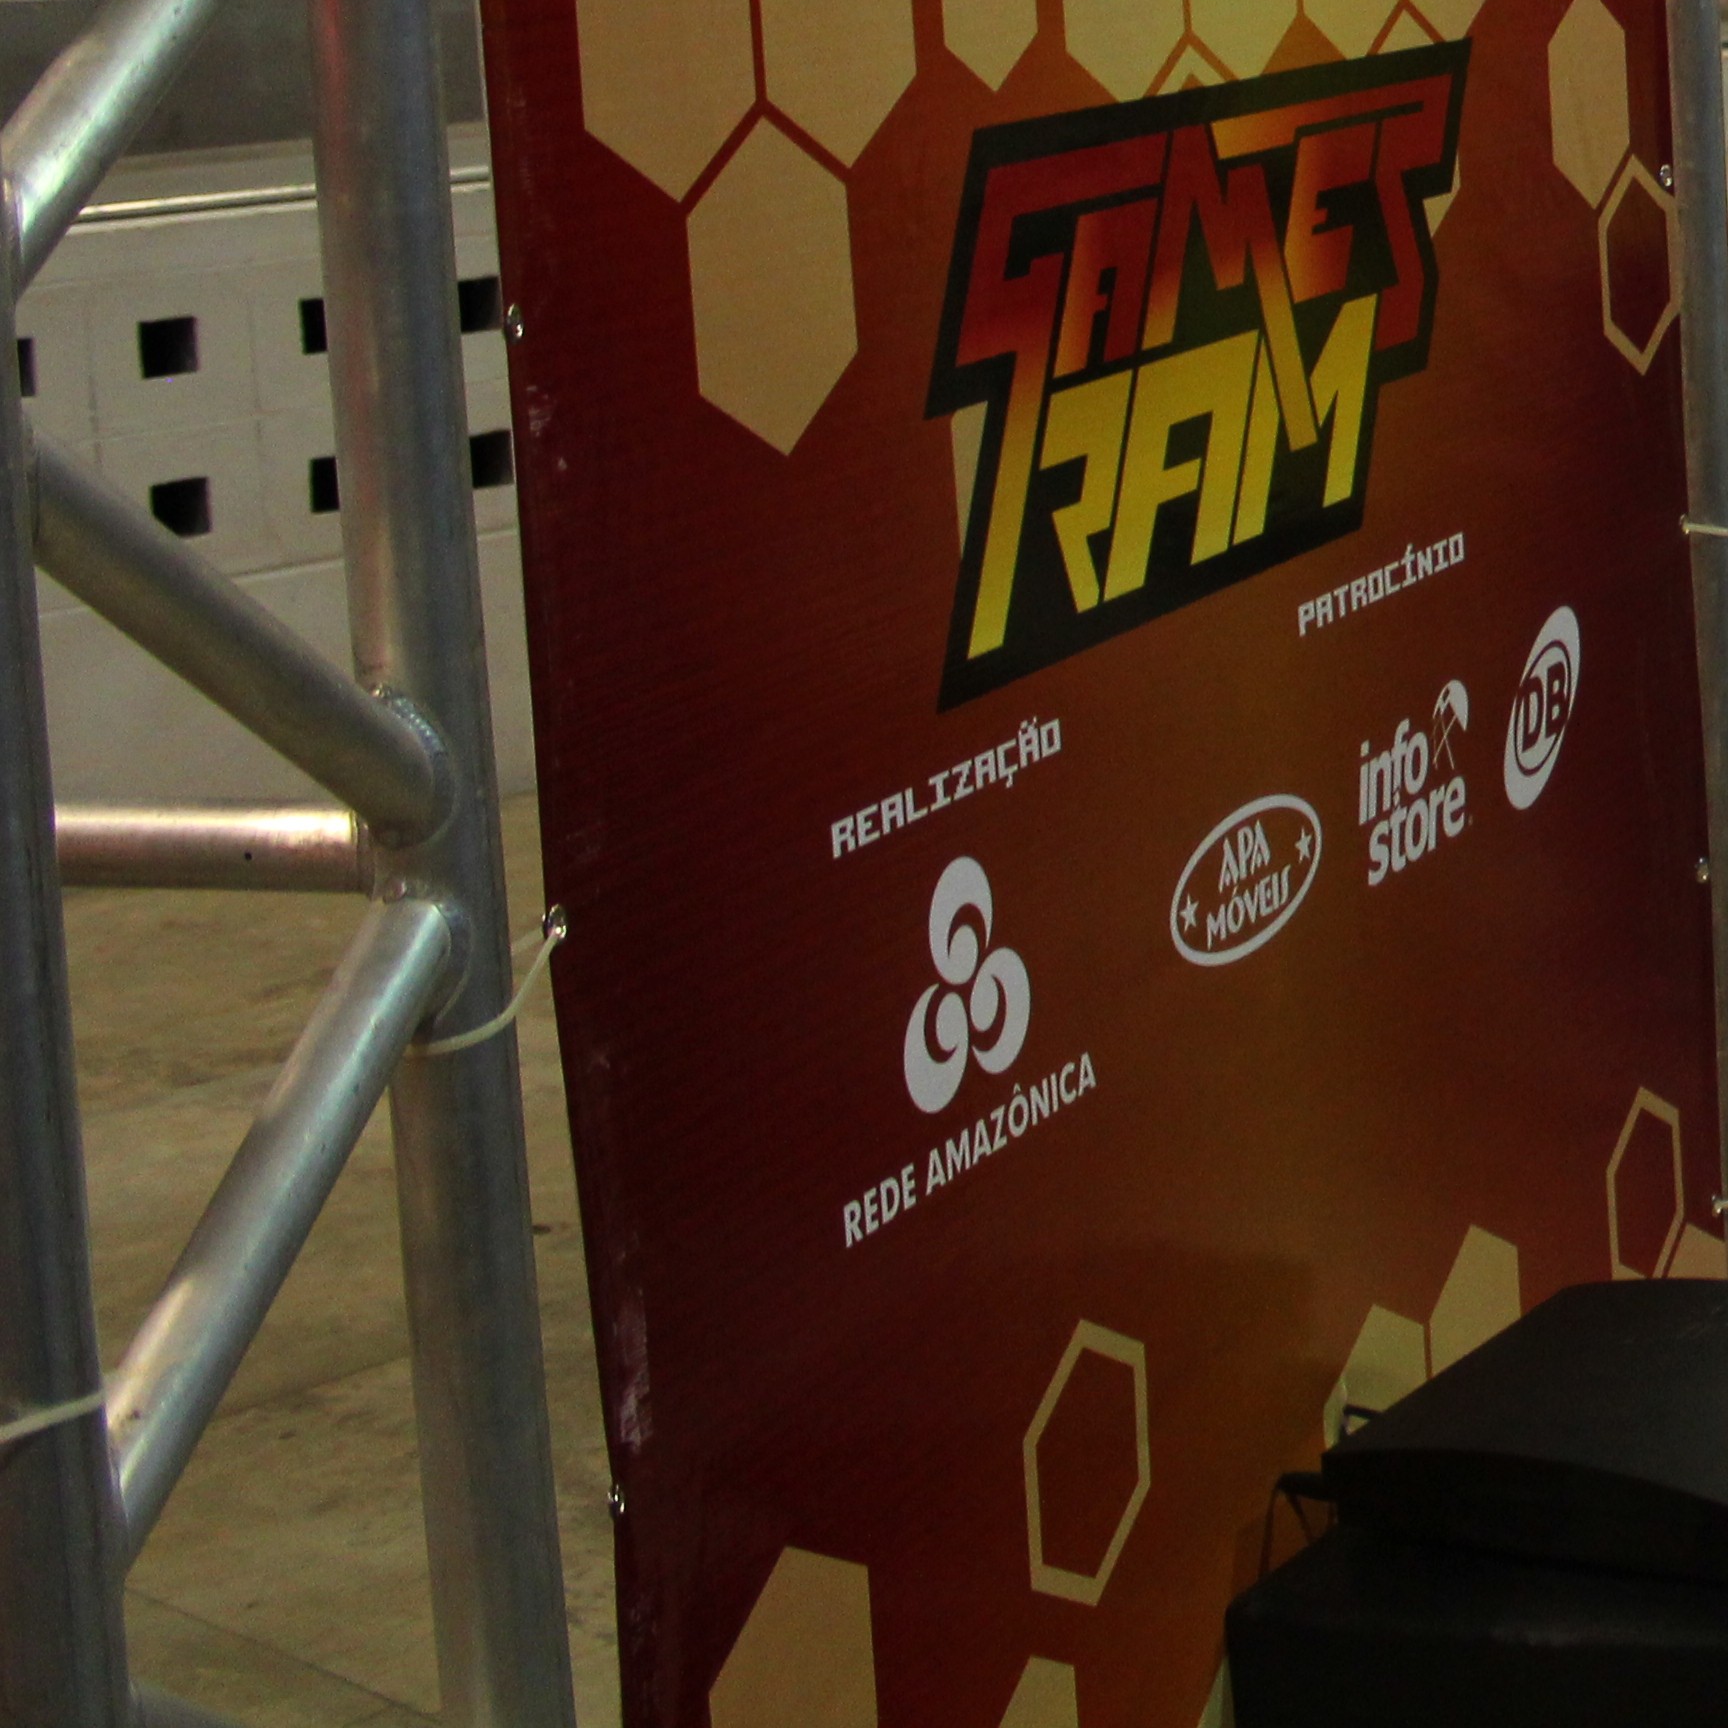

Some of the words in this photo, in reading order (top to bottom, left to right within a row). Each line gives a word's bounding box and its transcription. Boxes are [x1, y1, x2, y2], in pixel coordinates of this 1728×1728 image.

[956, 74, 1453, 382] GAMES
[968, 292, 1378, 660] RAM
[1298, 531, 1466, 637] PATROCÍNIO
[1516, 660, 1570, 758] DB
[831, 715, 1062, 859] REALIZAÇÃO
[1359, 718, 1429, 826] info
[1219, 819, 1271, 893] APA
[1368, 775, 1466, 886] store
[843, 1173, 916, 1249] REDE
[925, 1052, 1096, 1199] AMAZÔNICA
